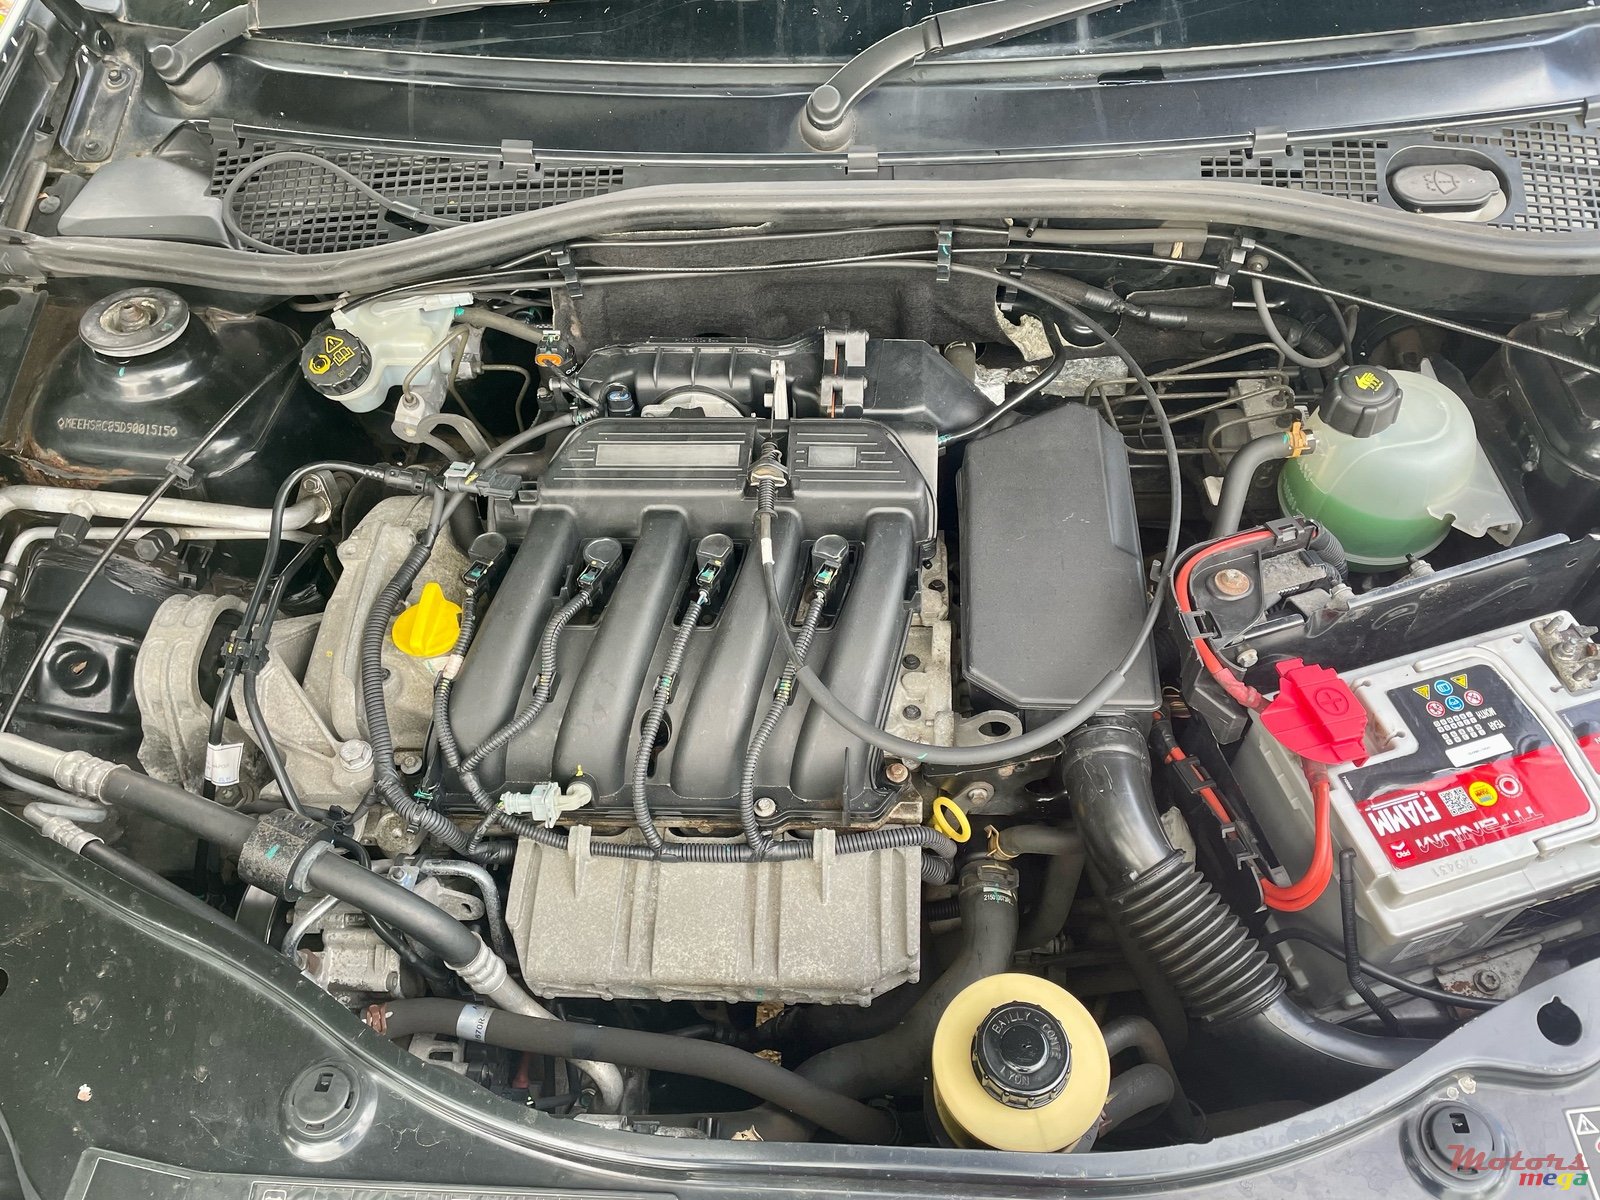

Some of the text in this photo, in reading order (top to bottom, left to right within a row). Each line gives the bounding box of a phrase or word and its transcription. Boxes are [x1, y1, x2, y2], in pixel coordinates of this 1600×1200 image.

[1487, 719, 1506, 731] YEAR
[1368, 797, 1441, 836] FIAMM
[1395, 849, 1411, 859] PRO
[991, 1011, 1031, 1034] BAILLY
